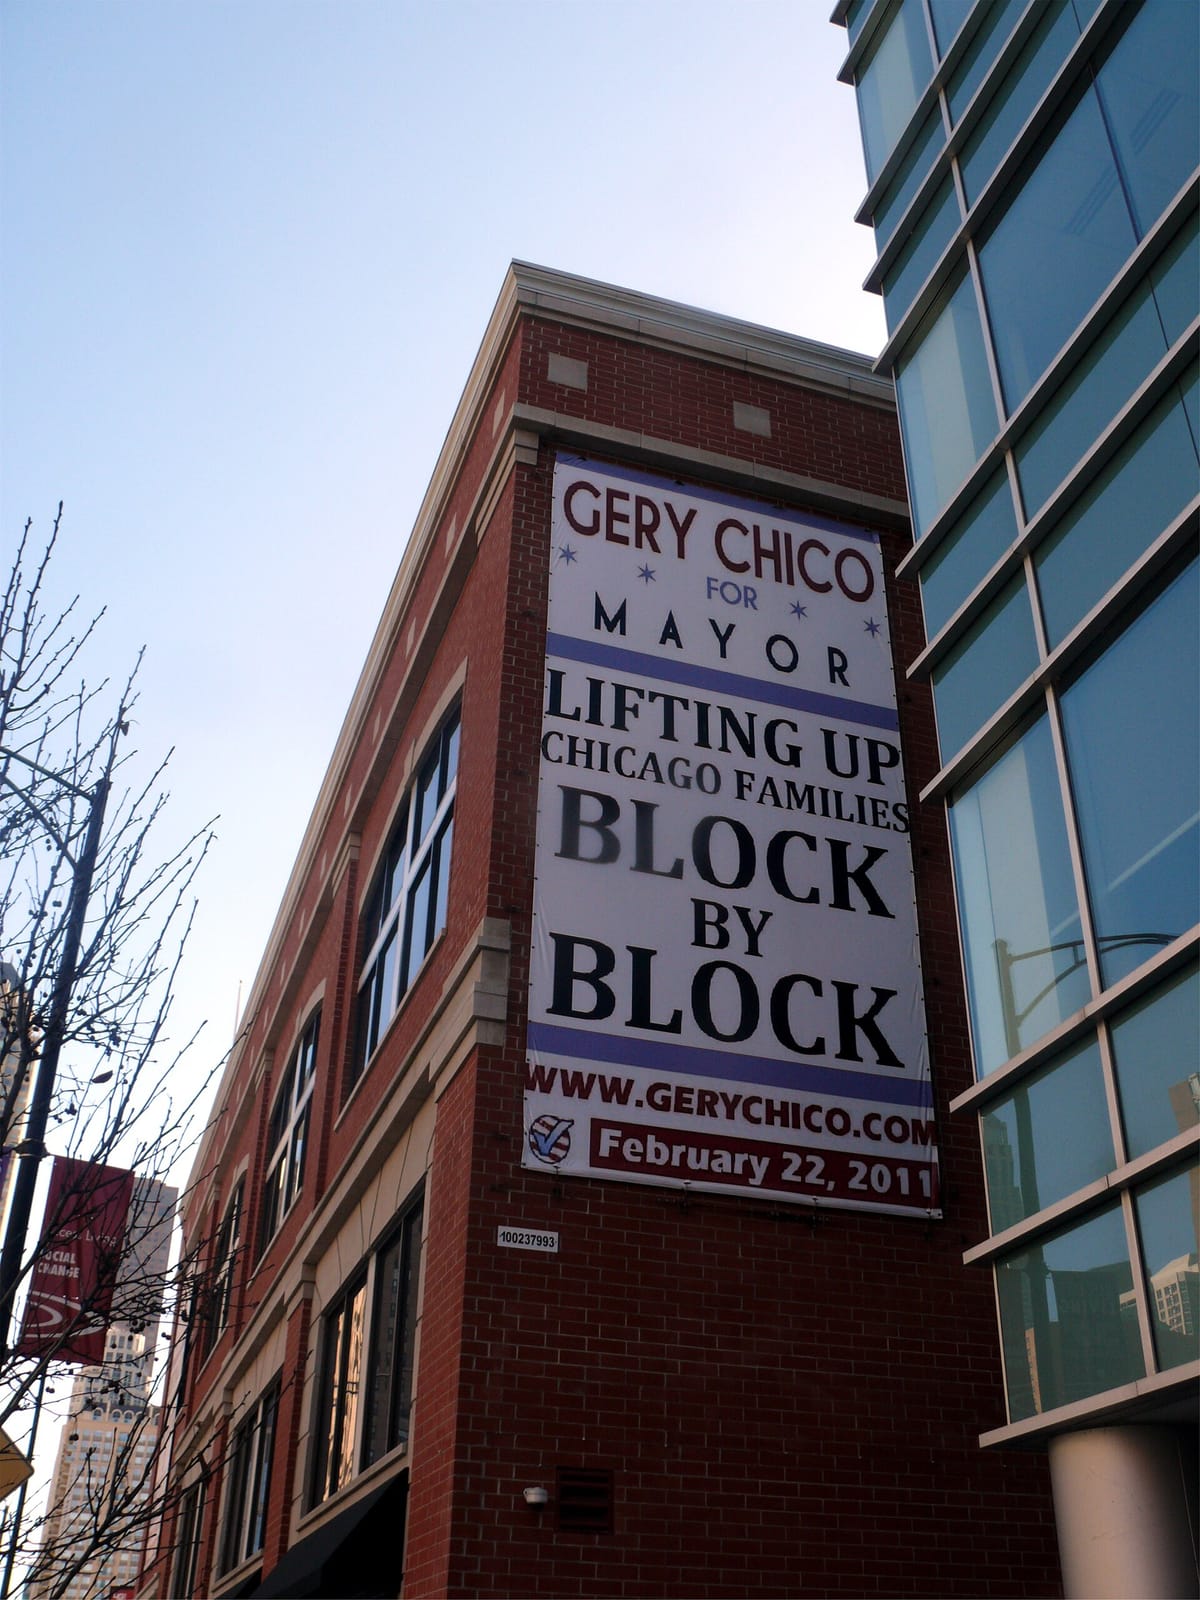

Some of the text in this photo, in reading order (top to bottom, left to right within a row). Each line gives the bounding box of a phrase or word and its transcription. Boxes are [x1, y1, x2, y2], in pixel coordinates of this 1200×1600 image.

[564, 480, 875, 603] GERY CHICO
[593, 591, 850, 687] MAYOR
[706, 576, 758, 610] FOR
[544, 668, 901, 786] LIFTING UP
[541, 731, 910, 834] CHICAGO FAMILIES
[554, 784, 896, 919] BLOCK
[690, 897, 773, 957] BY
[546, 931, 905, 1068] BLOCK
[523, 1064, 938, 1147] WWW.GERYCHICO.COM
[599, 1127, 931, 1198] February 22, 2011
[499, 1231, 555, 1248] 100237993
